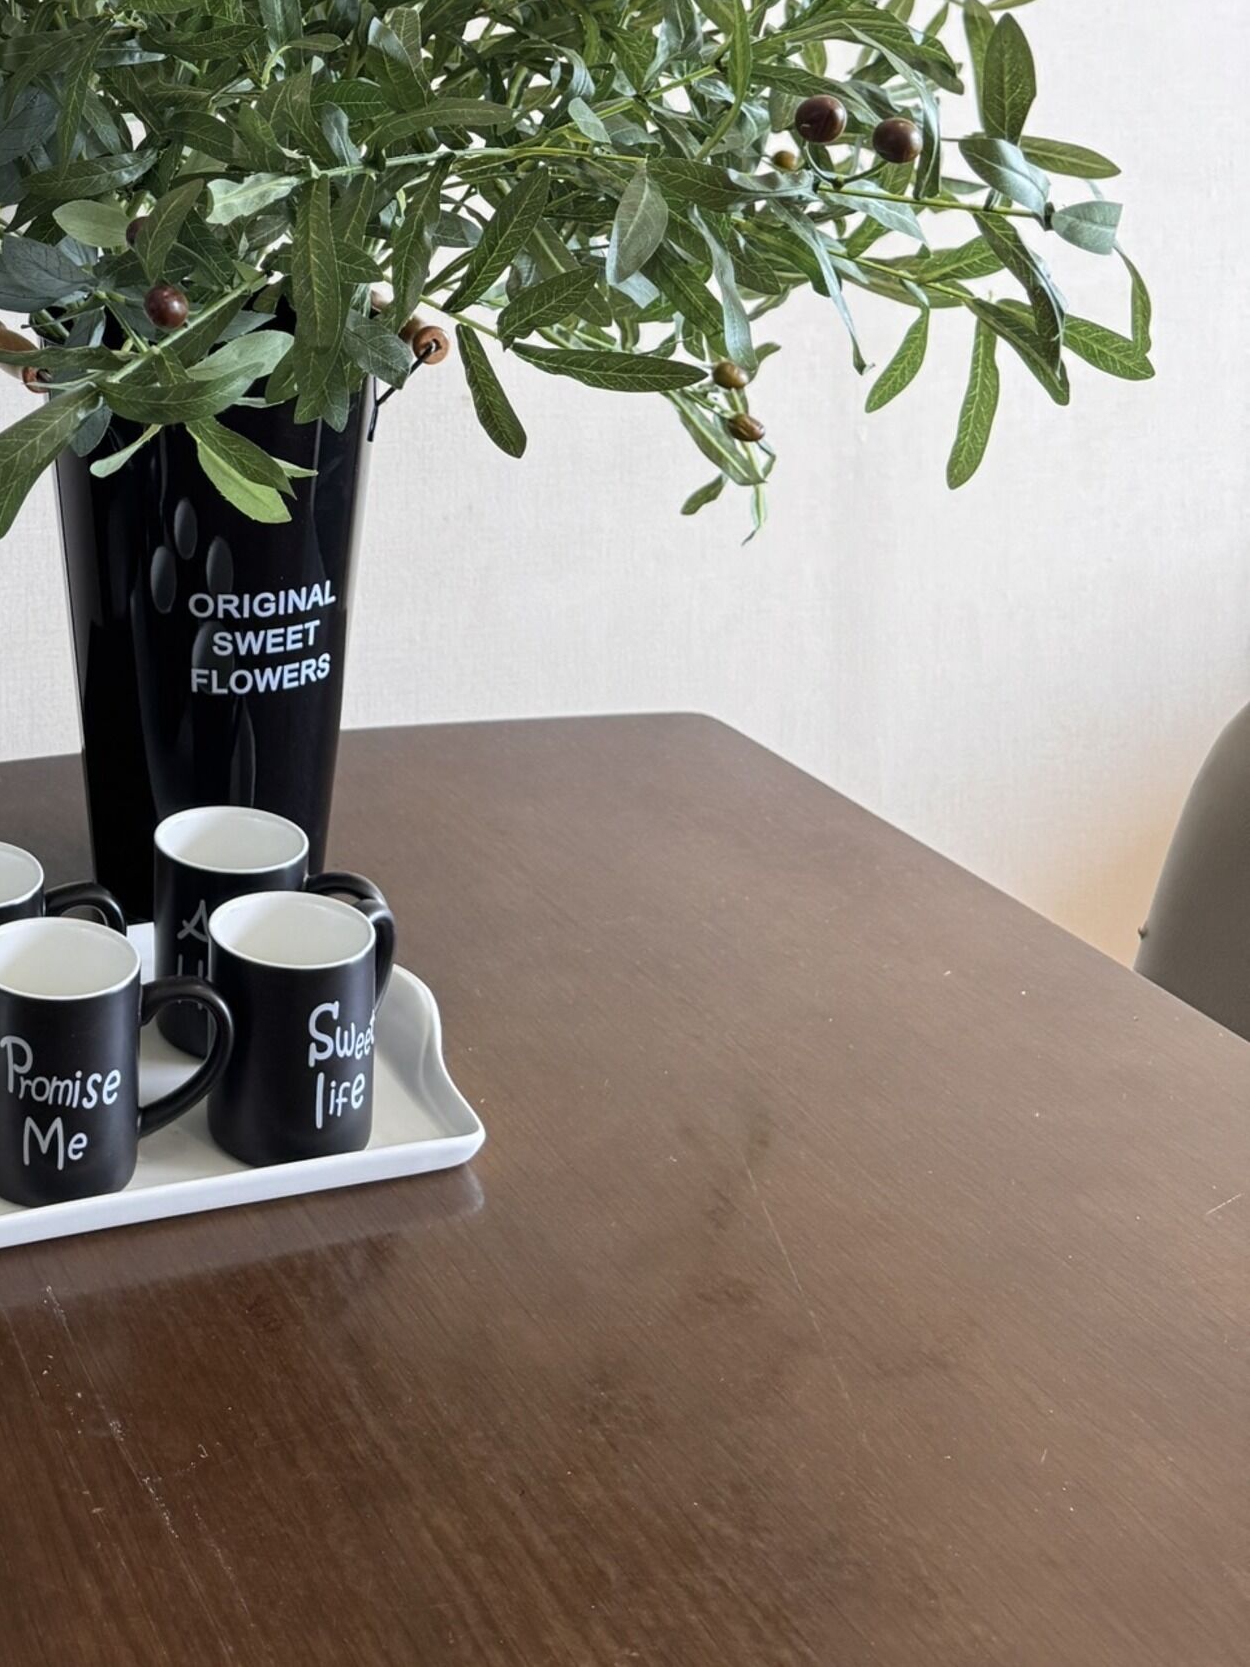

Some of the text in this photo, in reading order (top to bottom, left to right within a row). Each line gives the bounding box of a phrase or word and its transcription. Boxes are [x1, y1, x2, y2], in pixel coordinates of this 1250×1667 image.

[188, 579, 337, 619] ORIGINAL
[212, 619, 321, 656] SWEET
[190, 652, 332, 695] FLOWERS
[0, 1035, 122, 1110] Promise
[22, 1116, 88, 1171] Me
